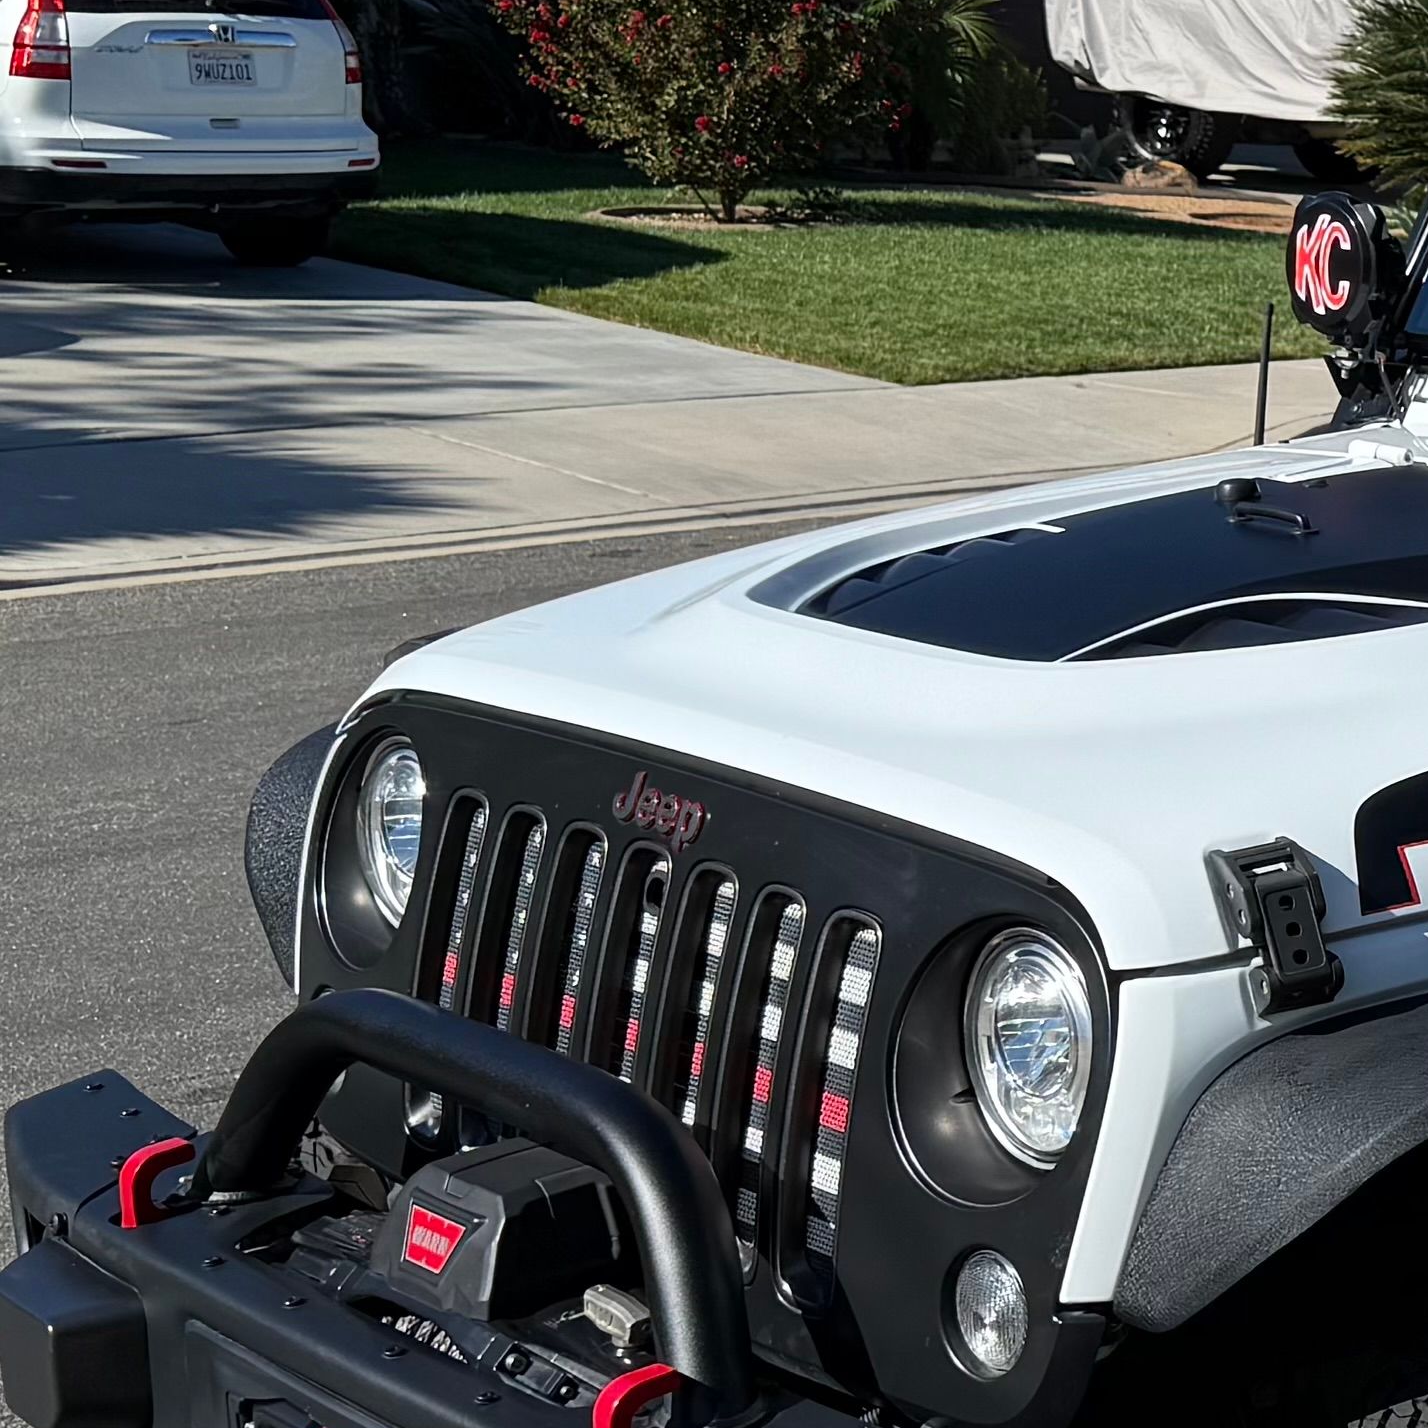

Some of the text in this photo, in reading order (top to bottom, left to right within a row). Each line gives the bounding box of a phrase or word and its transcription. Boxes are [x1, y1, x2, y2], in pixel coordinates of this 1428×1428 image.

[1295, 213, 1351, 315] KC
[612, 771, 706, 853] Jeep
[411, 1224, 450, 1257] WARN
